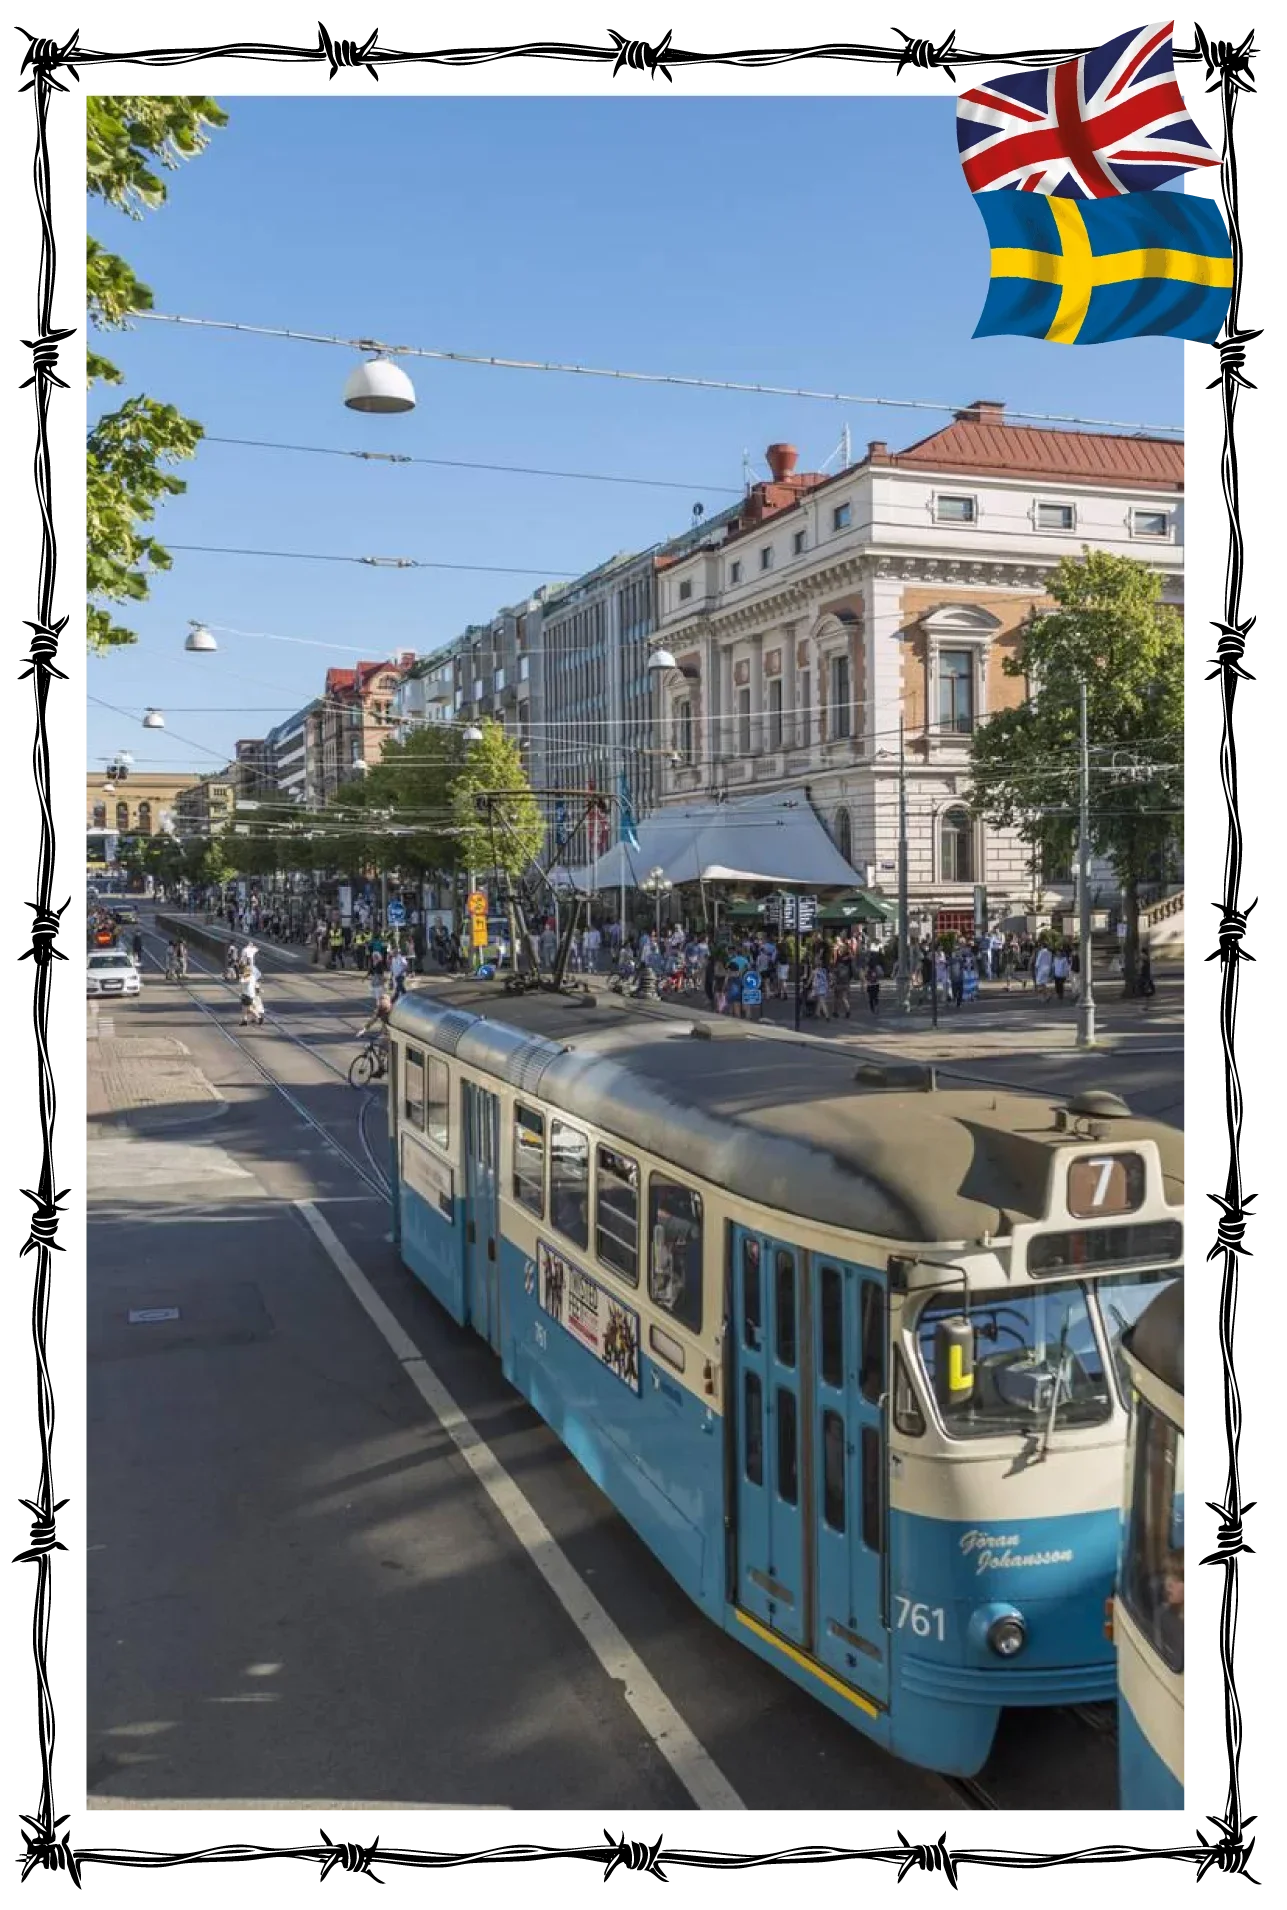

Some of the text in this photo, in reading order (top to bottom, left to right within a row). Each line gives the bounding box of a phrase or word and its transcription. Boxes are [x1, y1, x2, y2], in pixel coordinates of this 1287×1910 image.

[1088, 1156, 1114, 1207] 7
[959, 1529, 1020, 1556] Göran
[975, 1549, 1074, 1576] Johansson
[895, 1595, 946, 1642] 761
